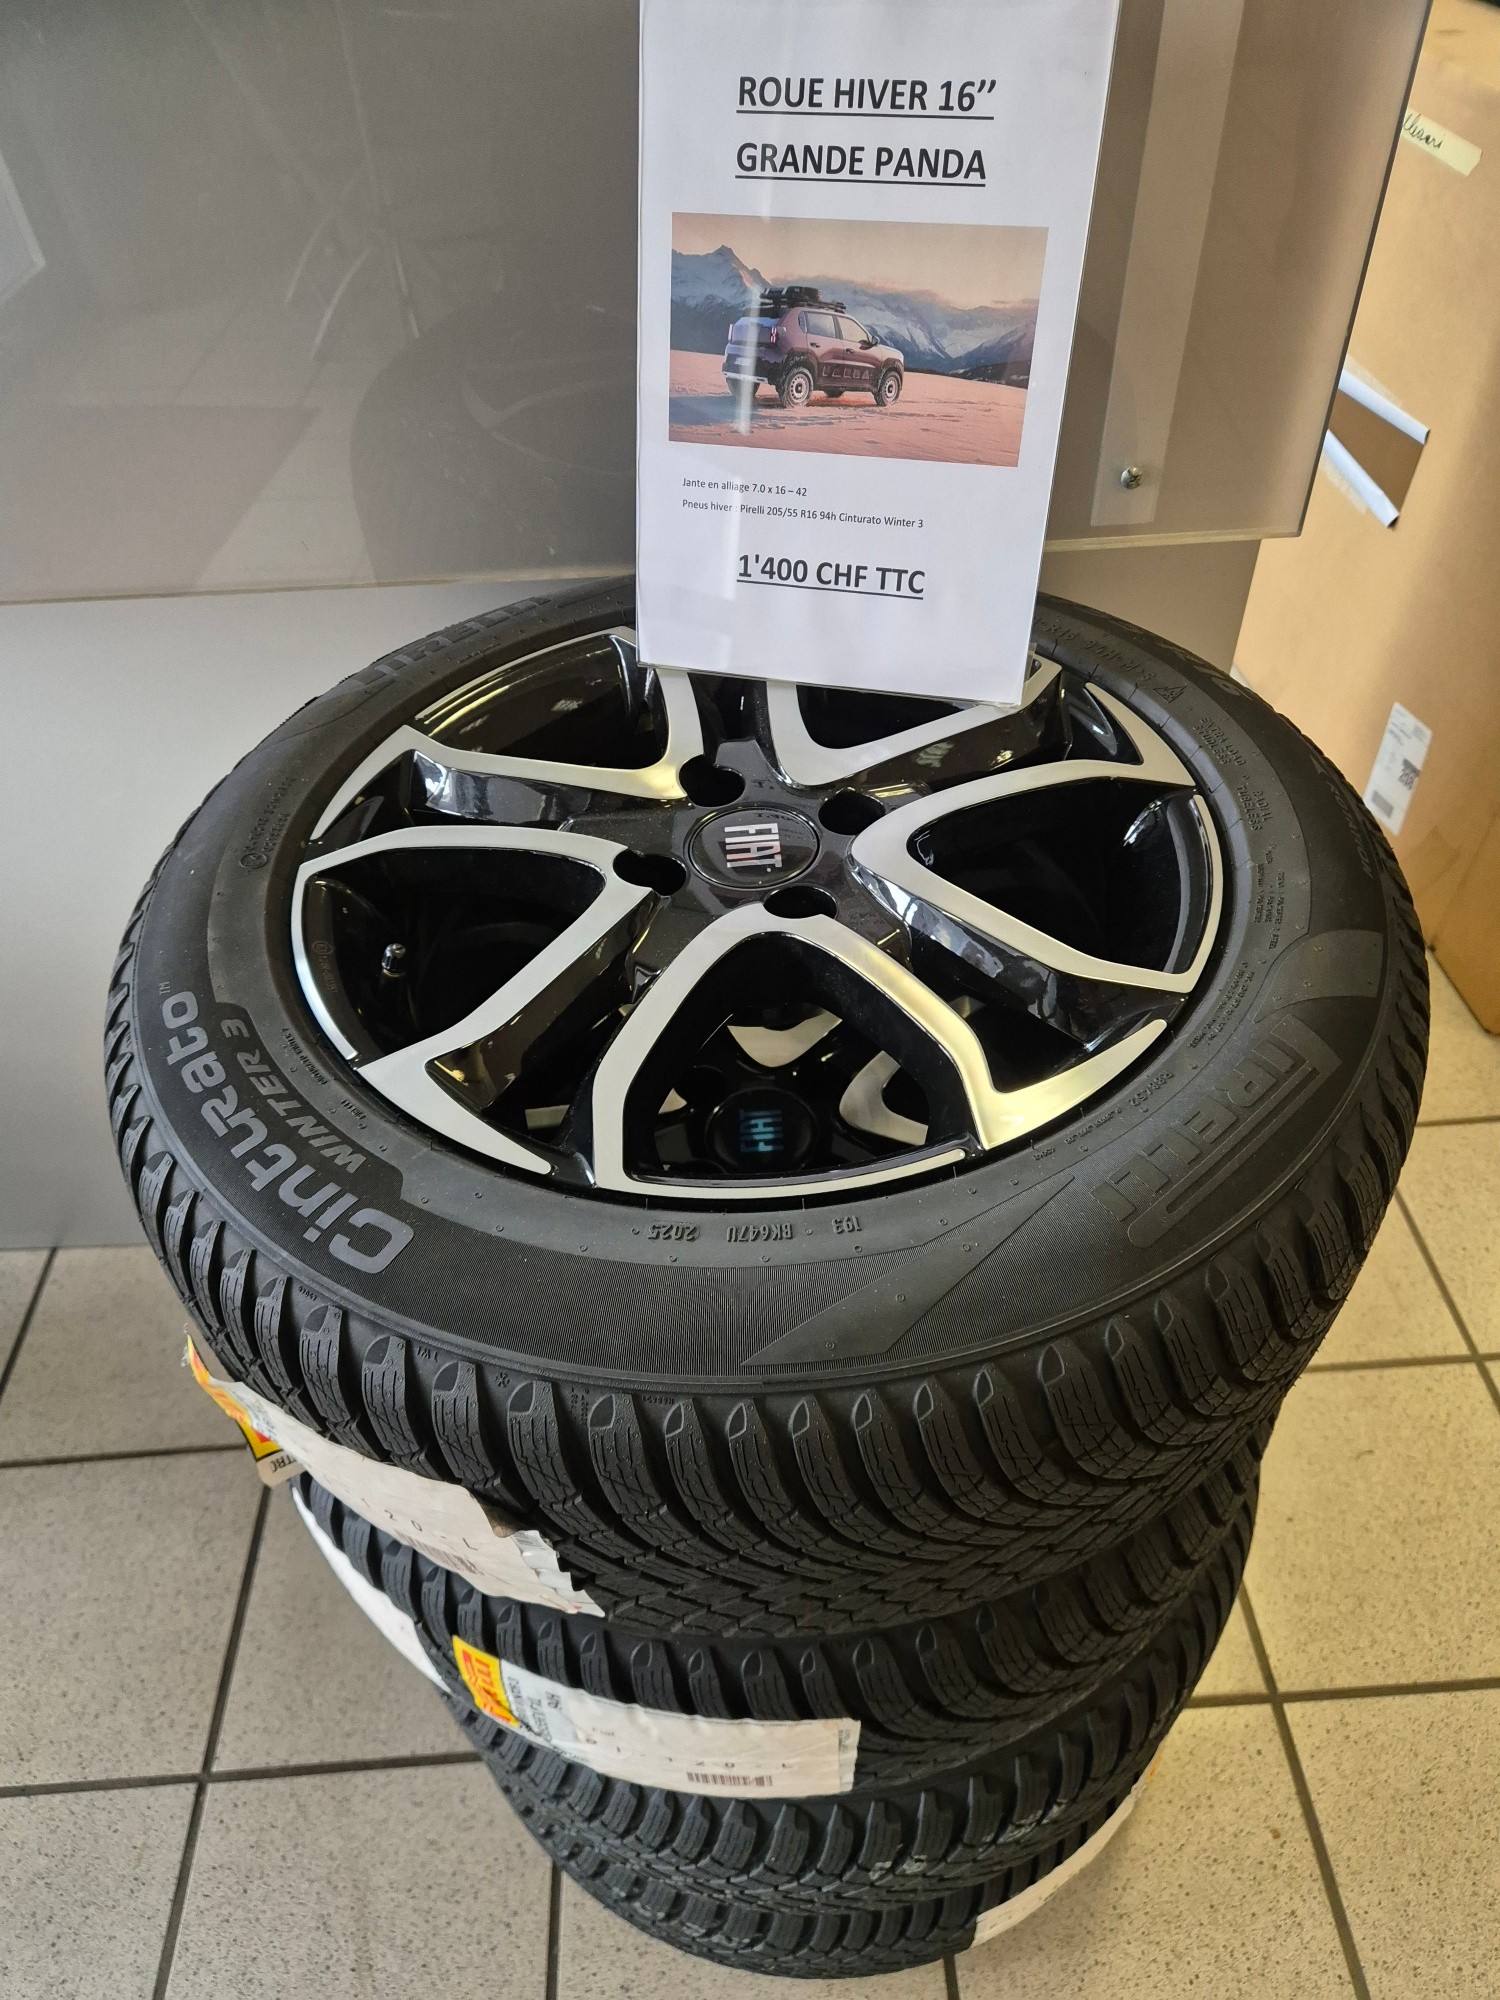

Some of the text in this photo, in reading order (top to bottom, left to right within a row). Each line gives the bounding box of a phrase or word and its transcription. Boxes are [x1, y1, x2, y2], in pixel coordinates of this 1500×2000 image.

[738, 76, 824, 109] ROUE
[833, 78, 928, 112] HIVER
[735, 142, 987, 180] GRANDE PANDA
[682, 478, 706, 488] Jante
[708, 481, 719, 489] en
[721, 481, 750, 493] alliage
[752, 483, 766, 493] 7.0
[775, 485, 786, 495] 16
[796, 487, 807, 497] 42
[682, 499, 709, 510] Pneus
[710, 501, 733, 512] hiver
[740, 504, 765, 515] Pirelli
[766, 506, 798, 518] 205/55
[800, 509, 818, 519] R16
[819, 510, 837, 521] 94h
[839, 512, 882, 525] Cinturato
[884, 516, 916, 528] Winter
[918, 519, 924, 528] 3
[738, 554, 926, 594] 1'400 CHF TTC
[725, 823, 783, 868] FIAT
[220, 1018, 251, 1041] 3
[237, 1048, 368, 1174] WINTER
[161, 990, 415, 1275] Cinturato
[1089, 1013, 1343, 1249] PIRELLI
[647, 1221, 700, 1242] 2025
